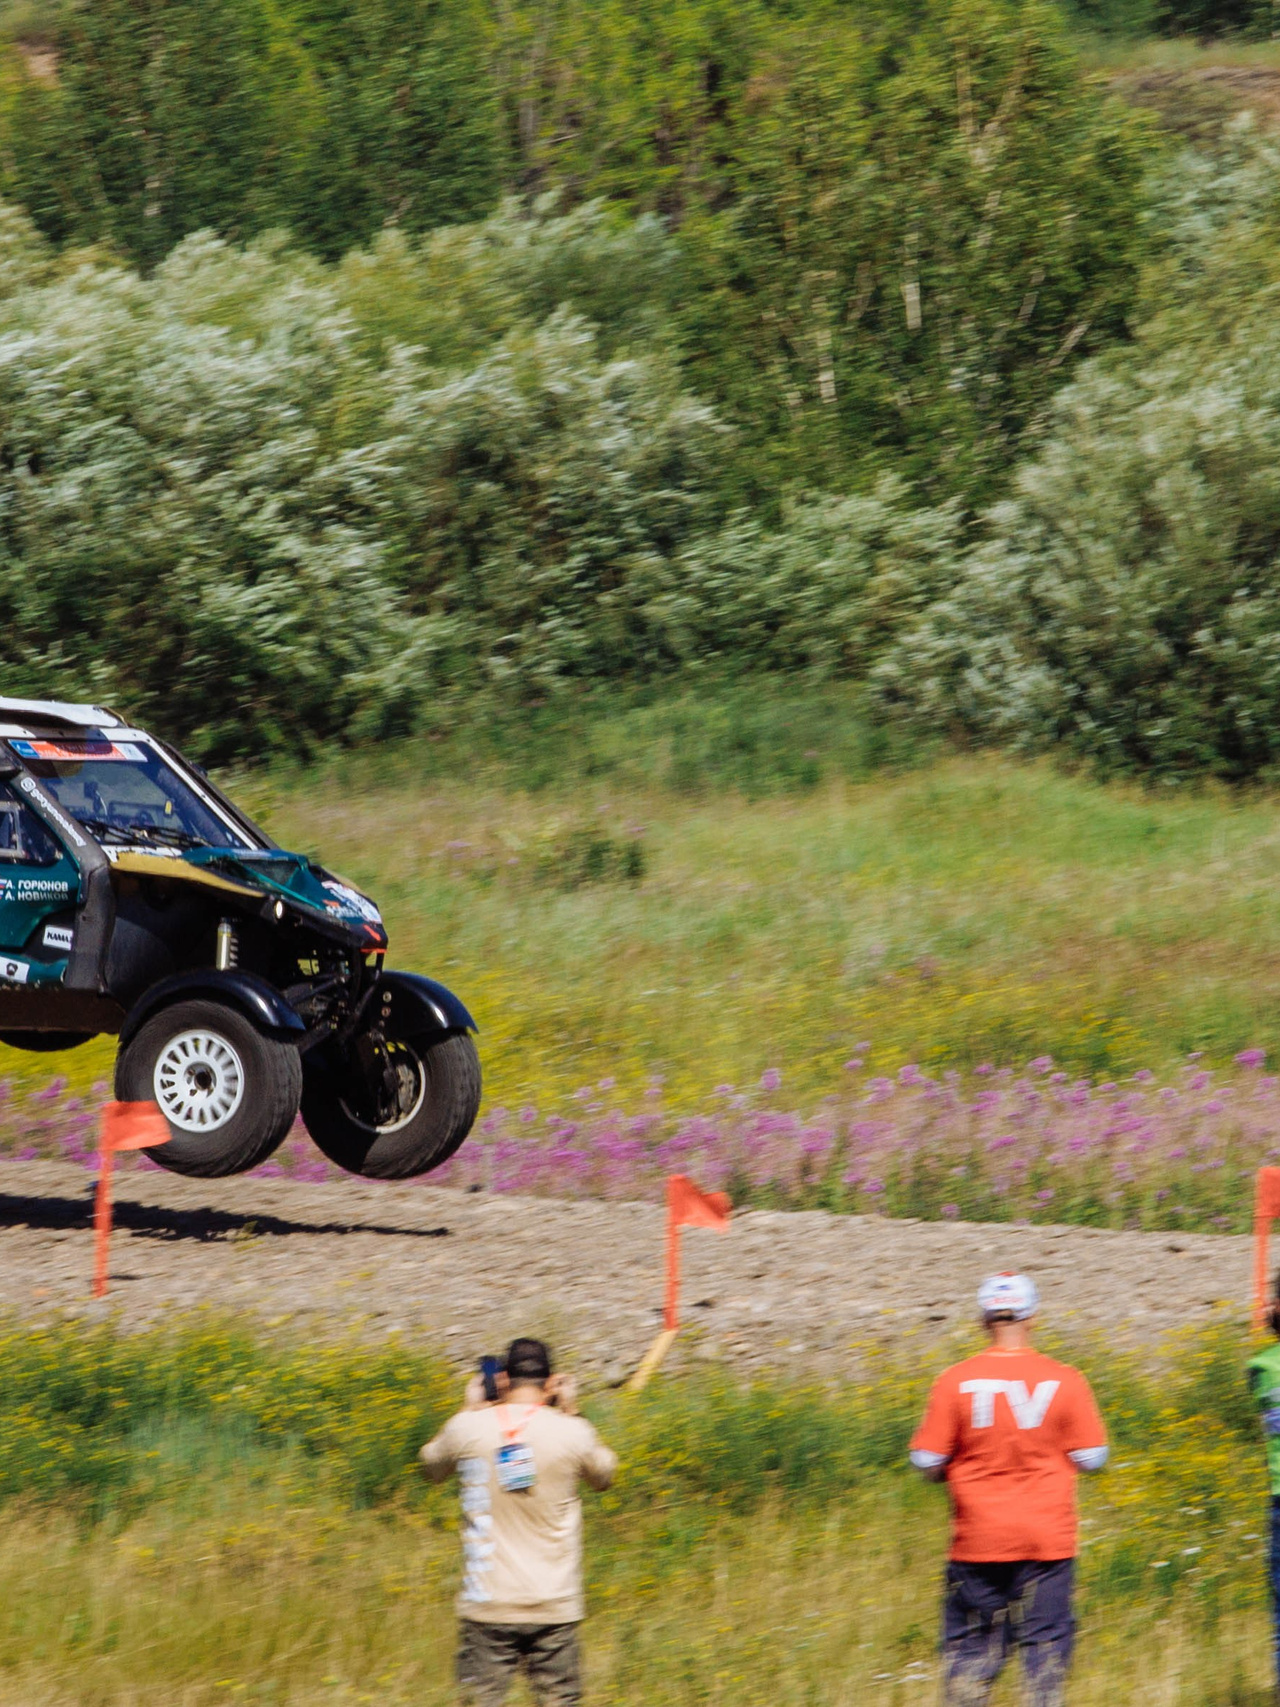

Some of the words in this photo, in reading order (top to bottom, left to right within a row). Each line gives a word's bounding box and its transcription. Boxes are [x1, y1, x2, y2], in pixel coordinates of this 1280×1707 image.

[18, 880, 69, 892] ГОРЮНОВ
[17, 891, 69, 900] НОВИКОВ
[959, 1379, 1061, 1429] TV
